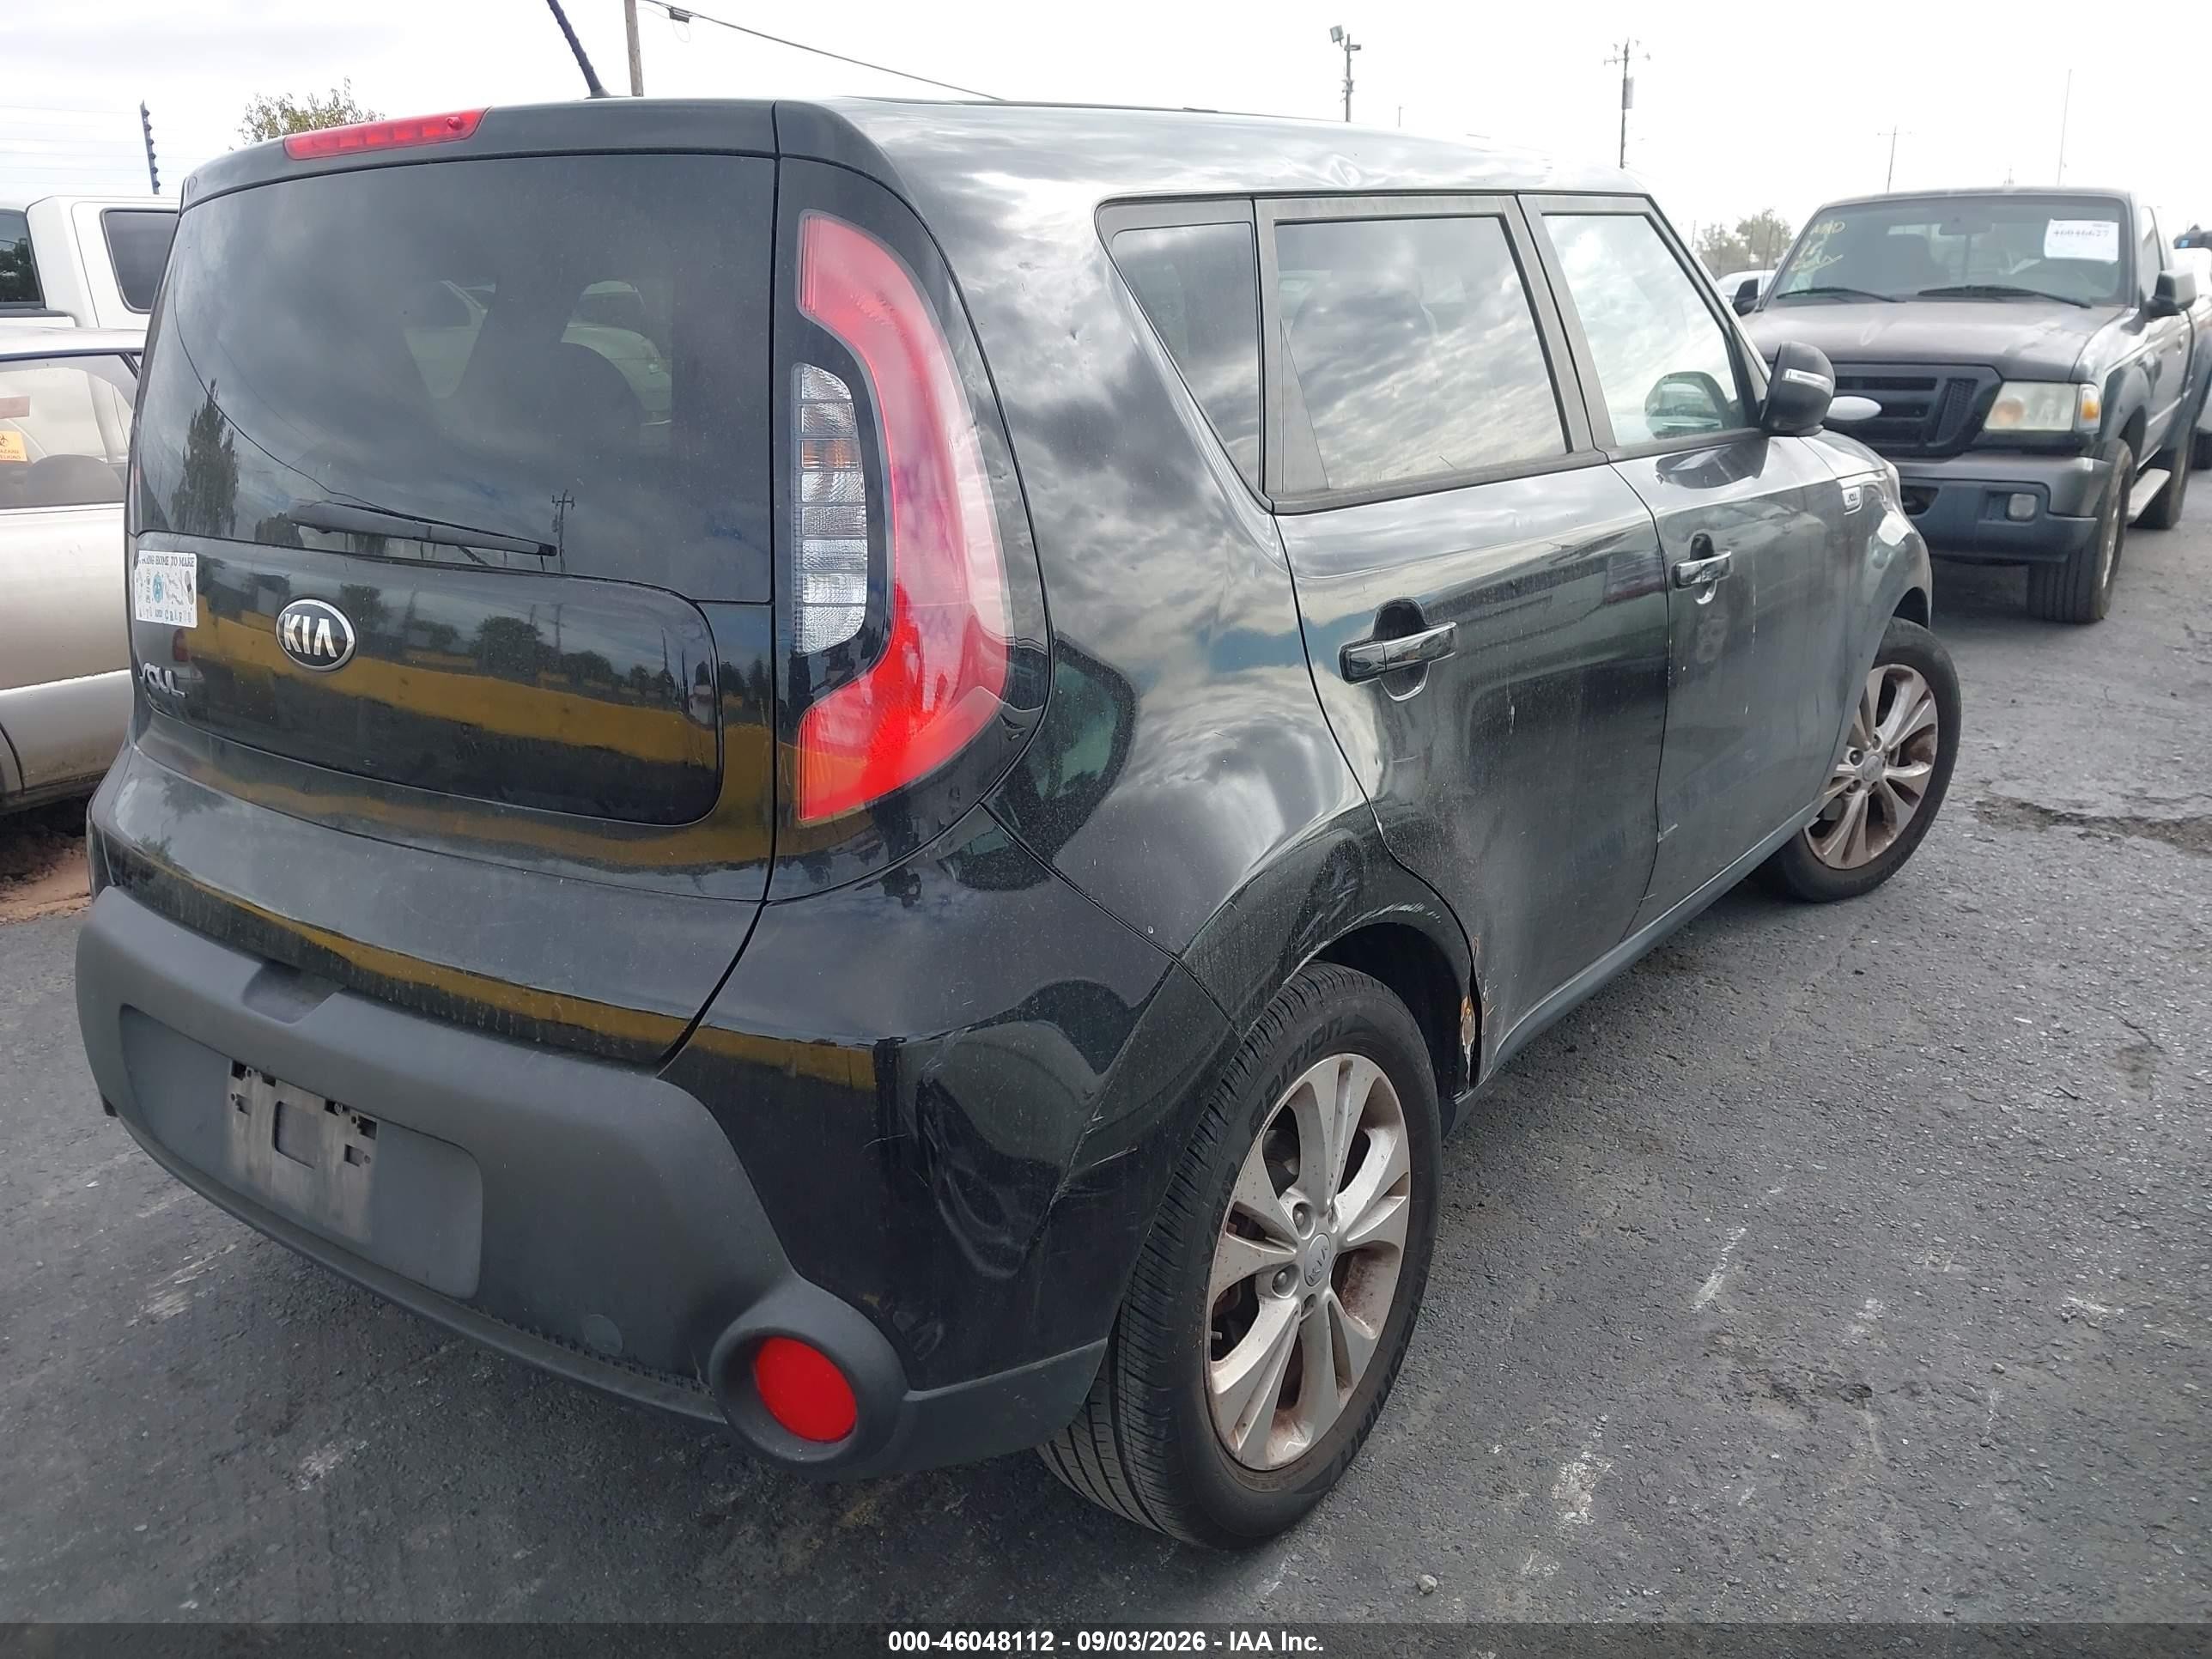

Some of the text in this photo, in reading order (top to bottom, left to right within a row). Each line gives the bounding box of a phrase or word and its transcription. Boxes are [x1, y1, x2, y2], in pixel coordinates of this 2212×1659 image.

[171, 556, 179, 567] TO
[179, 556, 196, 568] MAKE
[283, 613, 337, 659] KIA
